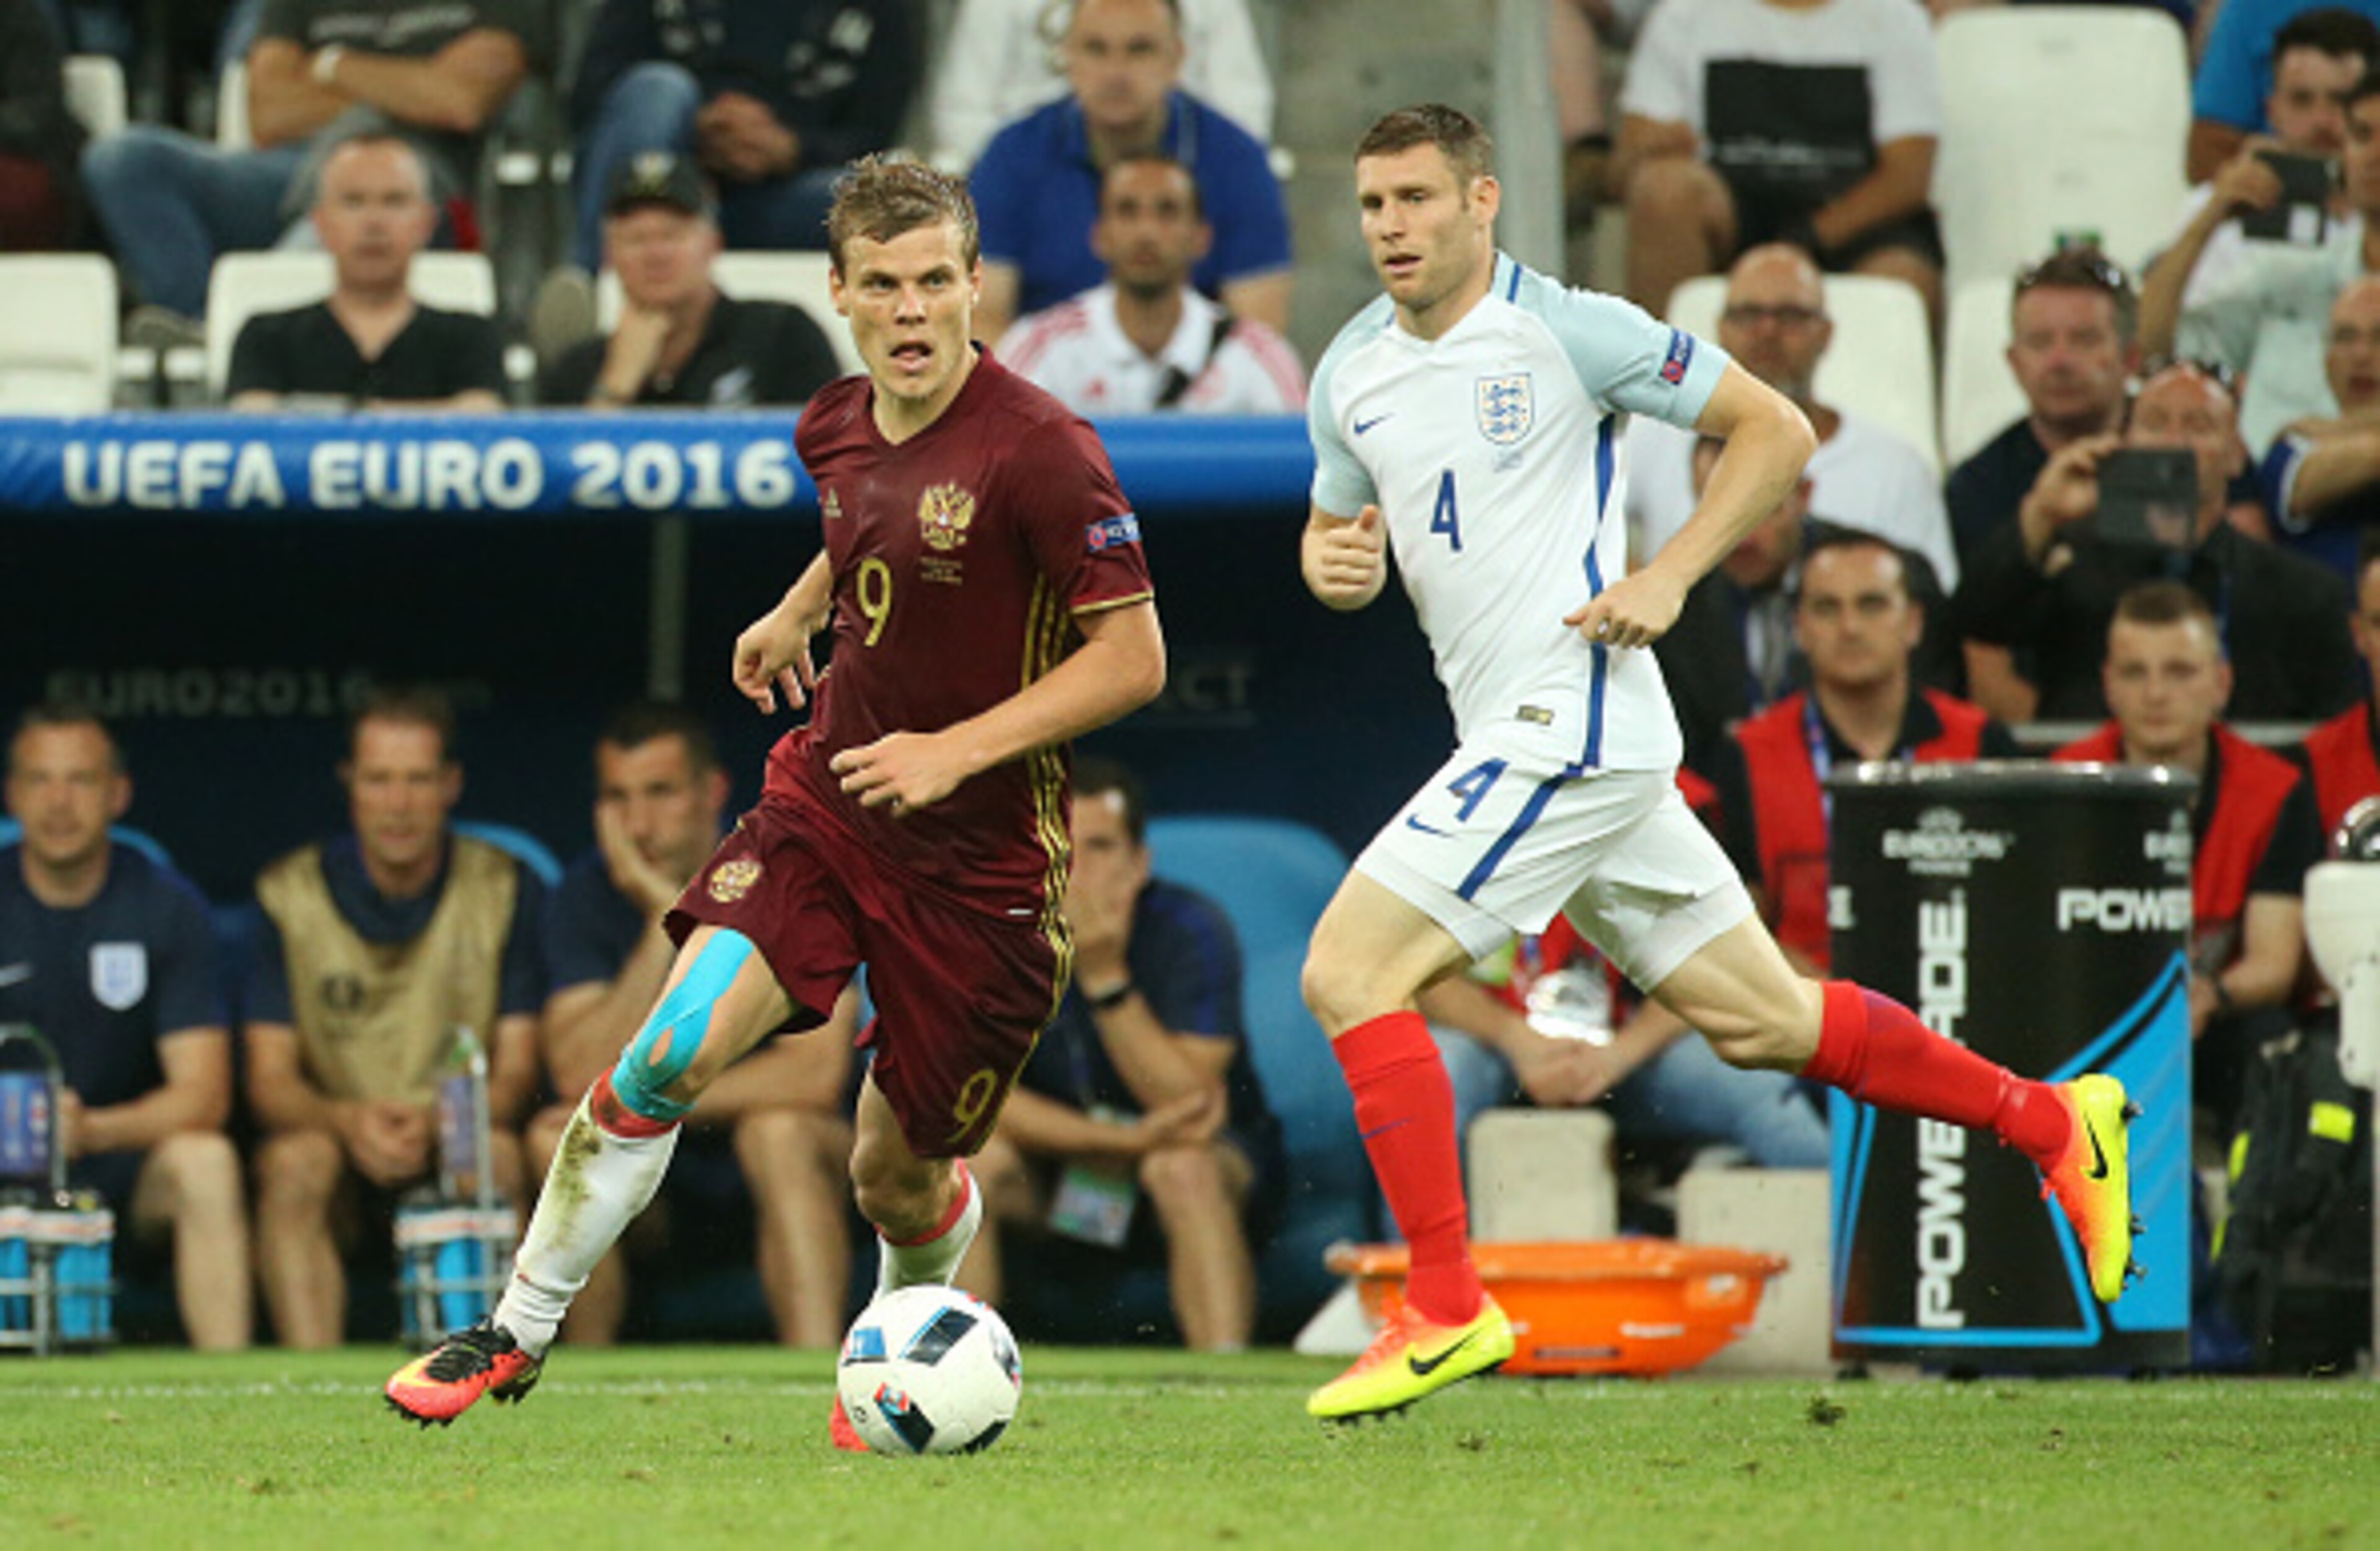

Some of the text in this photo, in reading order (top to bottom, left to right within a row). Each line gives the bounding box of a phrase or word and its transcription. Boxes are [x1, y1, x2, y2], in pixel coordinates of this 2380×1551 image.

[63, 438, 796, 510] UEFA EURO 2016
[1429, 469, 1462, 552] 4
[857, 558, 892, 648] 9
[1447, 756, 1509, 823] 4
[946, 1068, 997, 1144] 9
[1916, 900, 1968, 1329] POWEADE
